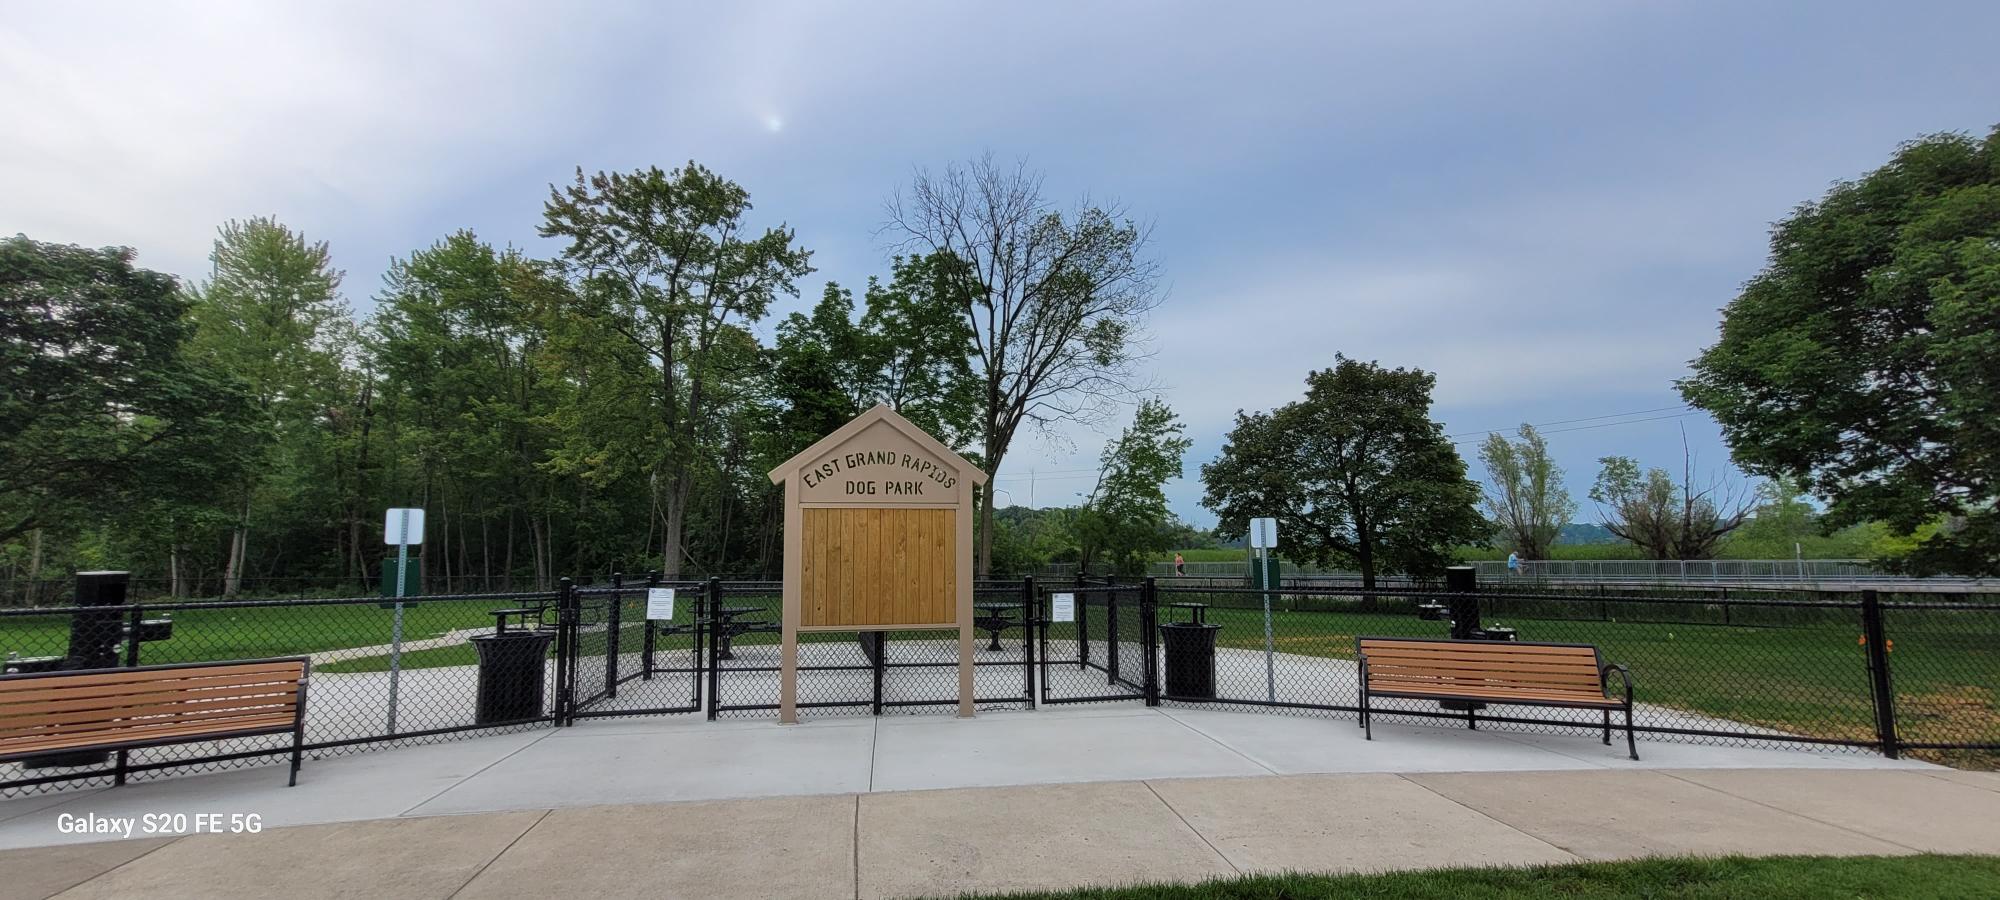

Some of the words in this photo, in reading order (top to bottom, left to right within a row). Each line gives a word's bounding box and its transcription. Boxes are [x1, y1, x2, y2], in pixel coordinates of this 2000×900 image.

[803, 459, 840, 488] EAST
[845, 451, 896, 468] GRAND
[901, 454, 956, 488] RAPIDS
[846, 481, 876, 495] DOG
[885, 481, 923, 495] PARK
